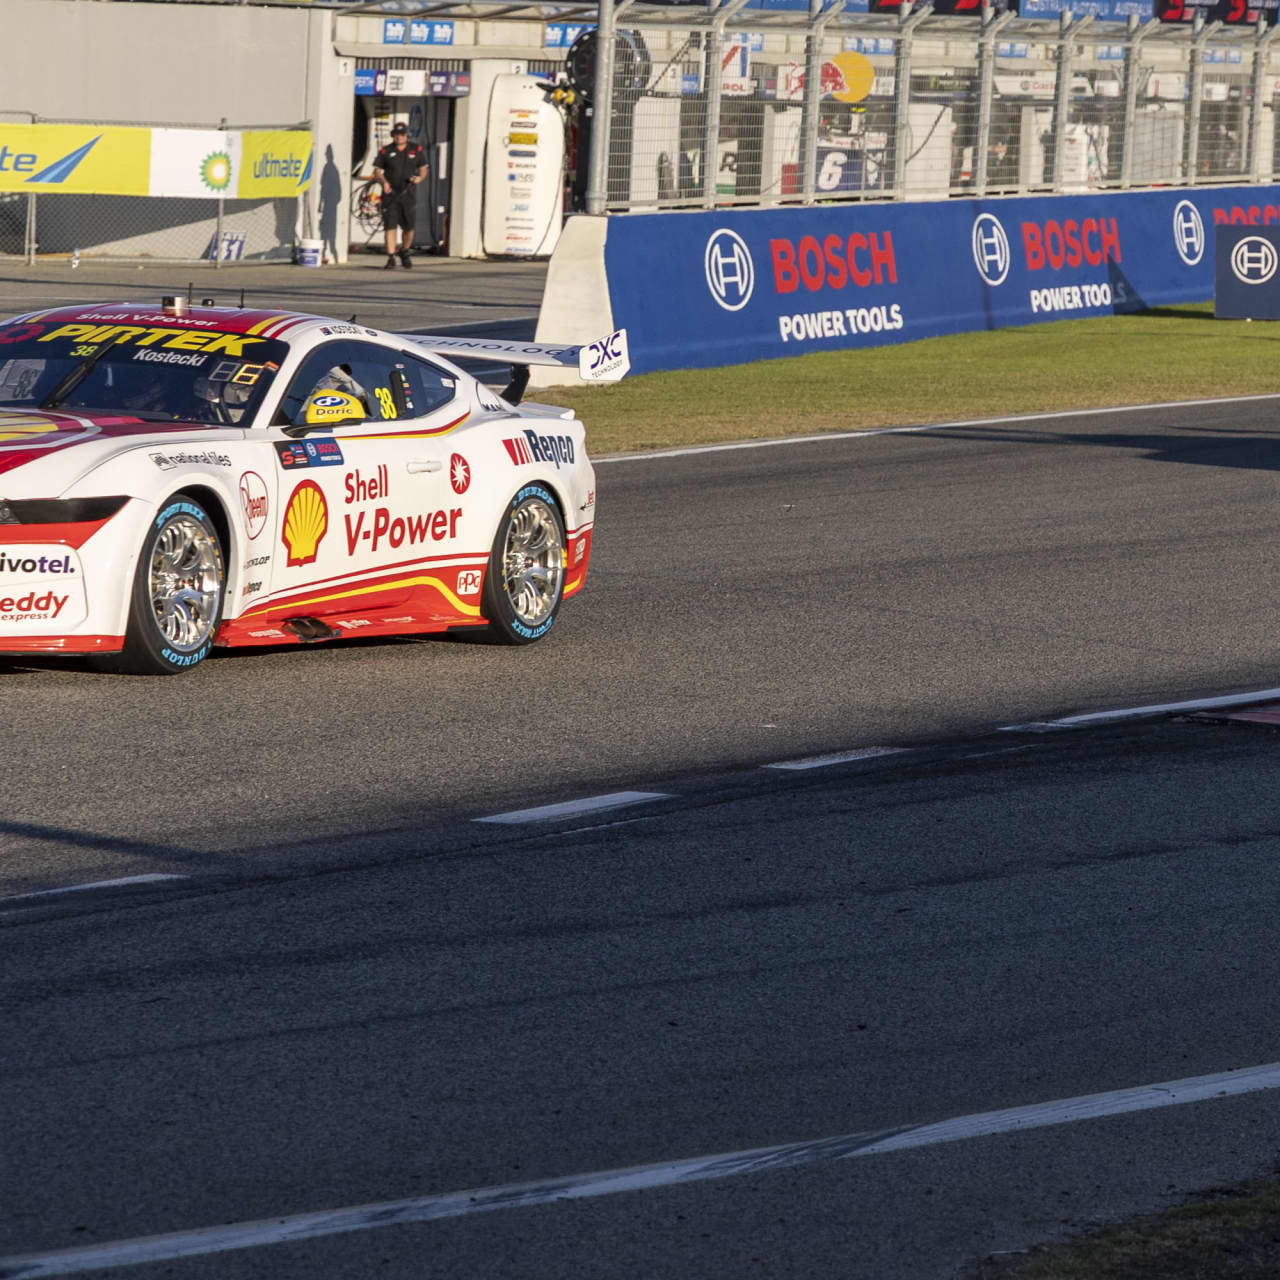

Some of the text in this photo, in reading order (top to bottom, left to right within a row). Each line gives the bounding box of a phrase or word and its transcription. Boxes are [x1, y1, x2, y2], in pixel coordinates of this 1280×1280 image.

[253, 153, 302, 178] ultimate
[818, 152, 848, 190] 6
[1022, 217, 1122, 271] BOSCH
[770, 231, 899, 294] BOSCH
[1030, 282, 1128, 313] POWER TOOLS
[77, 312, 219, 327] Shell V-Power
[779, 304, 904, 342] POWER TOOLS
[37, 324, 266, 357] PIRTEK
[70, 345, 98, 357] 38
[589, 333, 623, 370] DXC
[133, 348, 209, 368] Kostecki
[592, 359, 624, 378] TECHNOLOGY
[316, 408, 353, 416] Doric
[375, 388, 398, 420] 38
[522, 429, 575, 469] Repco
[344, 464, 389, 504] Shell
[517, 486, 555, 505] DUNLOP
[344, 508, 463, 557] V-Power
[458, 572, 481, 593] PPG
[1, 612, 49, 623] express
